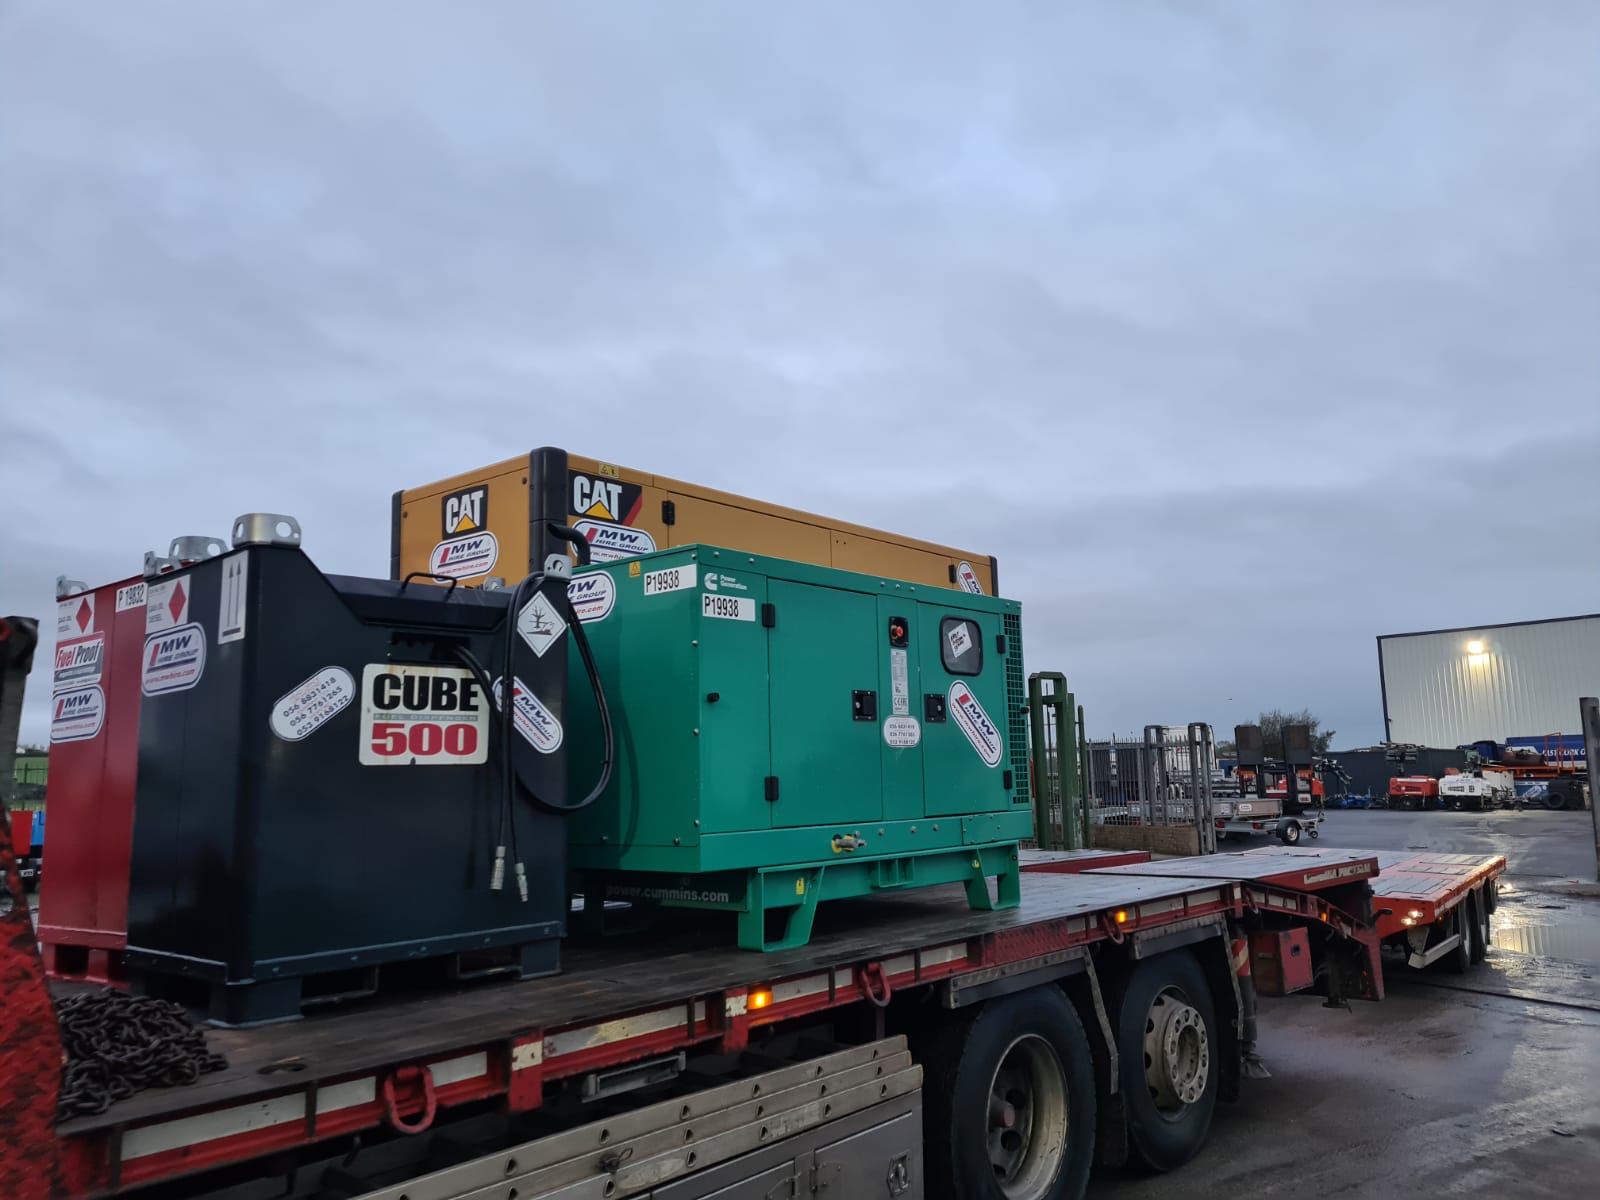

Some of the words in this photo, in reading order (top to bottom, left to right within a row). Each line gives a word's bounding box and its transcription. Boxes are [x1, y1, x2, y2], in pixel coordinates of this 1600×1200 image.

[573, 475, 622, 521] CAT
[445, 490, 484, 534] CAT
[599, 529, 639, 543] MW
[451, 539, 483, 554] MW
[466, 548, 491, 558] GROUP
[595, 539, 616, 547] HIRE
[619, 543, 649, 552] GROUP
[646, 569, 680, 594] P19938
[577, 590, 607, 600] GROUP
[704, 595, 739, 618] P19938
[160, 634, 192, 654] MW
[56, 646, 76, 669] Fuel
[75, 639, 102, 664] Proof
[65, 694, 92, 708] MW
[373, 673, 479, 711] CUBE
[283, 704, 300, 718] 056
[520, 696, 553, 725] MW
[969, 703, 995, 736] MW
[289, 713, 307, 727] 056
[296, 722, 313, 736] 053
[371, 722, 477, 756] 500
[605, 886, 729, 903] power.cummins.com
